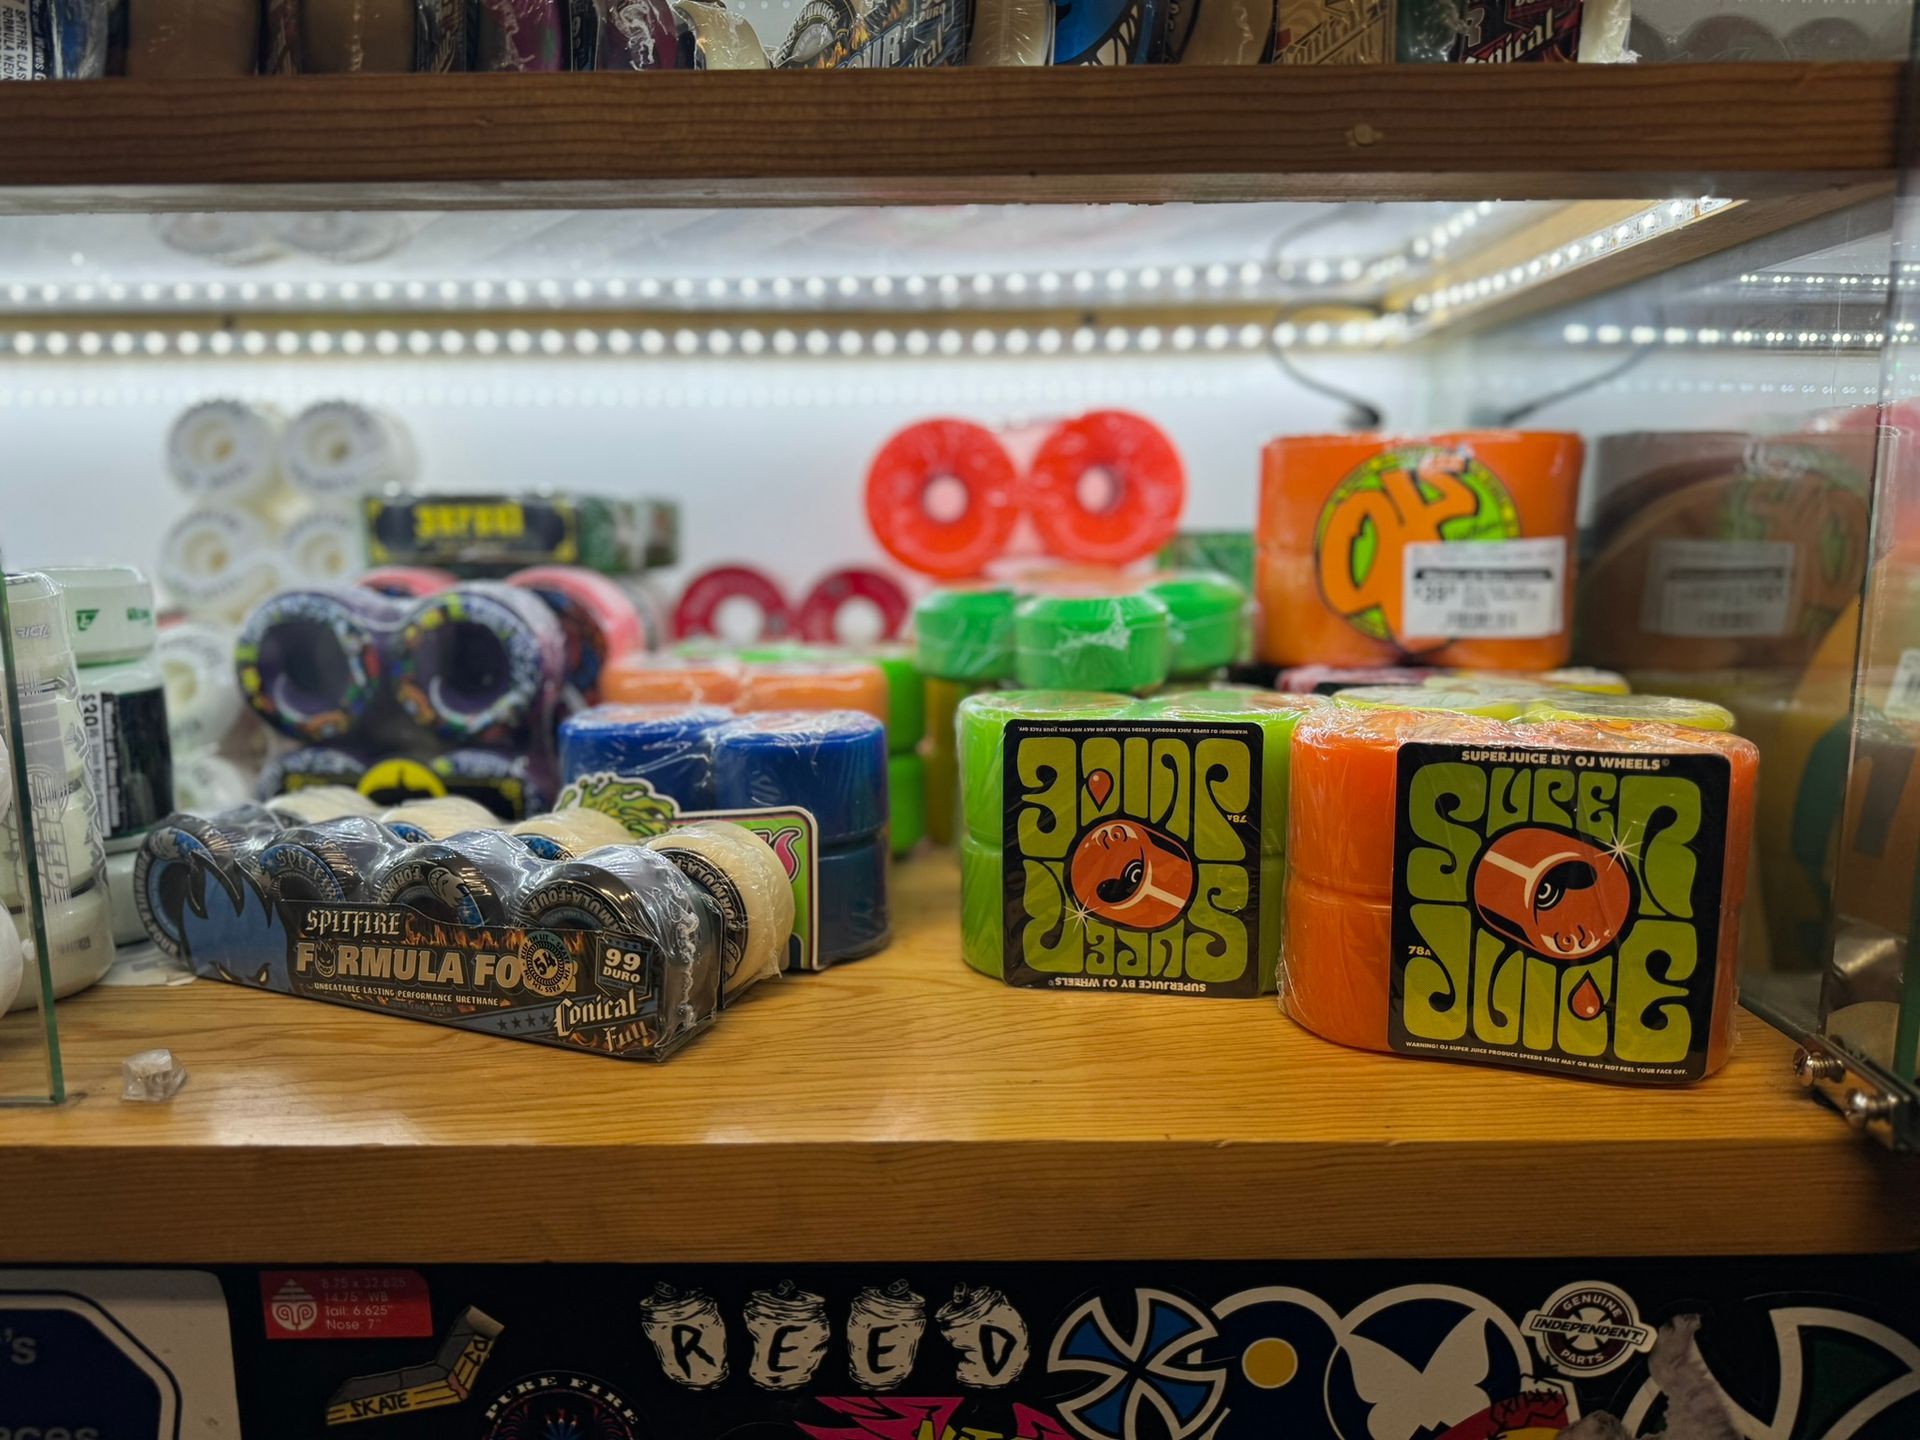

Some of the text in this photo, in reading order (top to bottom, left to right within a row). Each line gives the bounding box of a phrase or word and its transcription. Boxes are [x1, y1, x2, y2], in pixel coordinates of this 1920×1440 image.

[3, 6, 15, 51] FORMULA
[15, 9, 28, 52] SPITFIRE
[1464, 7, 1551, 64] nical
[1461, 750, 1547, 764] SUPERJUICE
[1551, 753, 1570, 766] BY
[1575, 755, 1595, 768] OJ
[1017, 737, 1250, 861] JUICE
[1406, 762, 1701, 919] SUPER
[305, 909, 401, 937] SPITFIRE
[1022, 859, 1249, 983] SUPER
[605, 948, 641, 971] 99
[602, 966, 641, 983] DURO
[1102, 978, 1118, 987] OJ
[1120, 979, 1136, 989] BY
[1139, 980, 1206, 992] SUPERJUICE
[1403, 903, 1698, 1063] JUICE
[314, 982, 499, 1007] UNBEATABLE LASTING PERFORMANCE URETHANE
[554, 988, 638, 1037] Conical
[1405, 1041, 1439, 1050] WARNING!
[1449, 1045, 1469, 1053] SUPER
[1488, 1049, 1518, 1058] PRODUCE
[1519, 1053, 1542, 1061] SPEEDS
[1544, 1056, 1560, 1064] THAT
[1561, 1058, 1576, 1066] MAY
[1588, 1062, 1603, 1070] MAY
[1605, 1064, 1619, 1072] NOT
[368, 1291, 389, 1302] WB
[1562, 1294, 1623, 1318] GENUINE
[353, 1305, 393, 1316] 6.625"
[1560, 1348, 1605, 1365] PARTS
[350, 1391, 411, 1418] SKATE
[569, 1377, 639, 1425] FIRE
